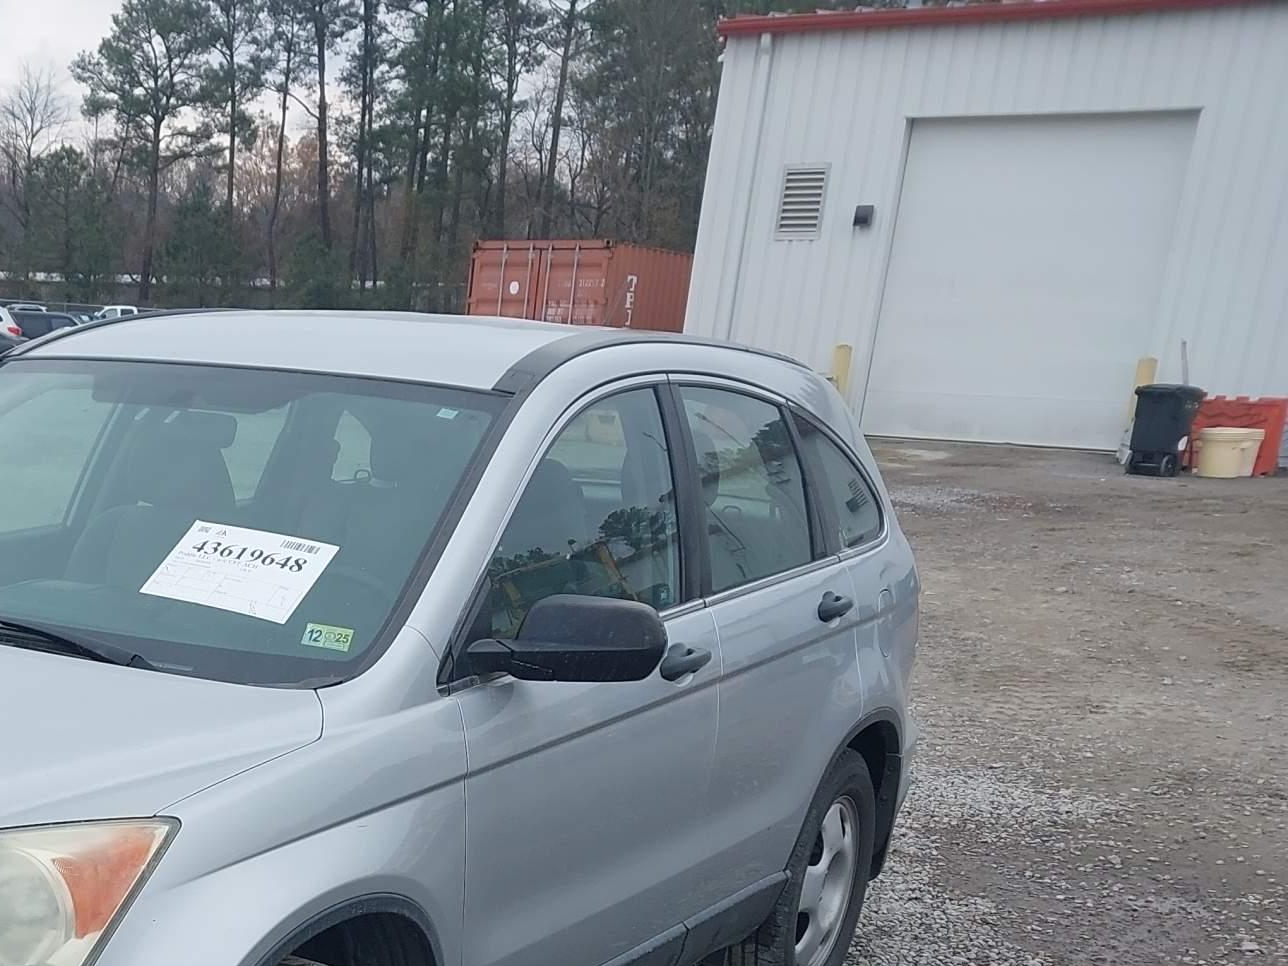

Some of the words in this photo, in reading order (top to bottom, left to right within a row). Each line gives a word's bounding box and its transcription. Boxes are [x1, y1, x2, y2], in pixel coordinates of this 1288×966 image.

[192, 540, 308, 574] 43619648
[307, 628, 323, 643] 12
[335, 632, 350, 644] 25
